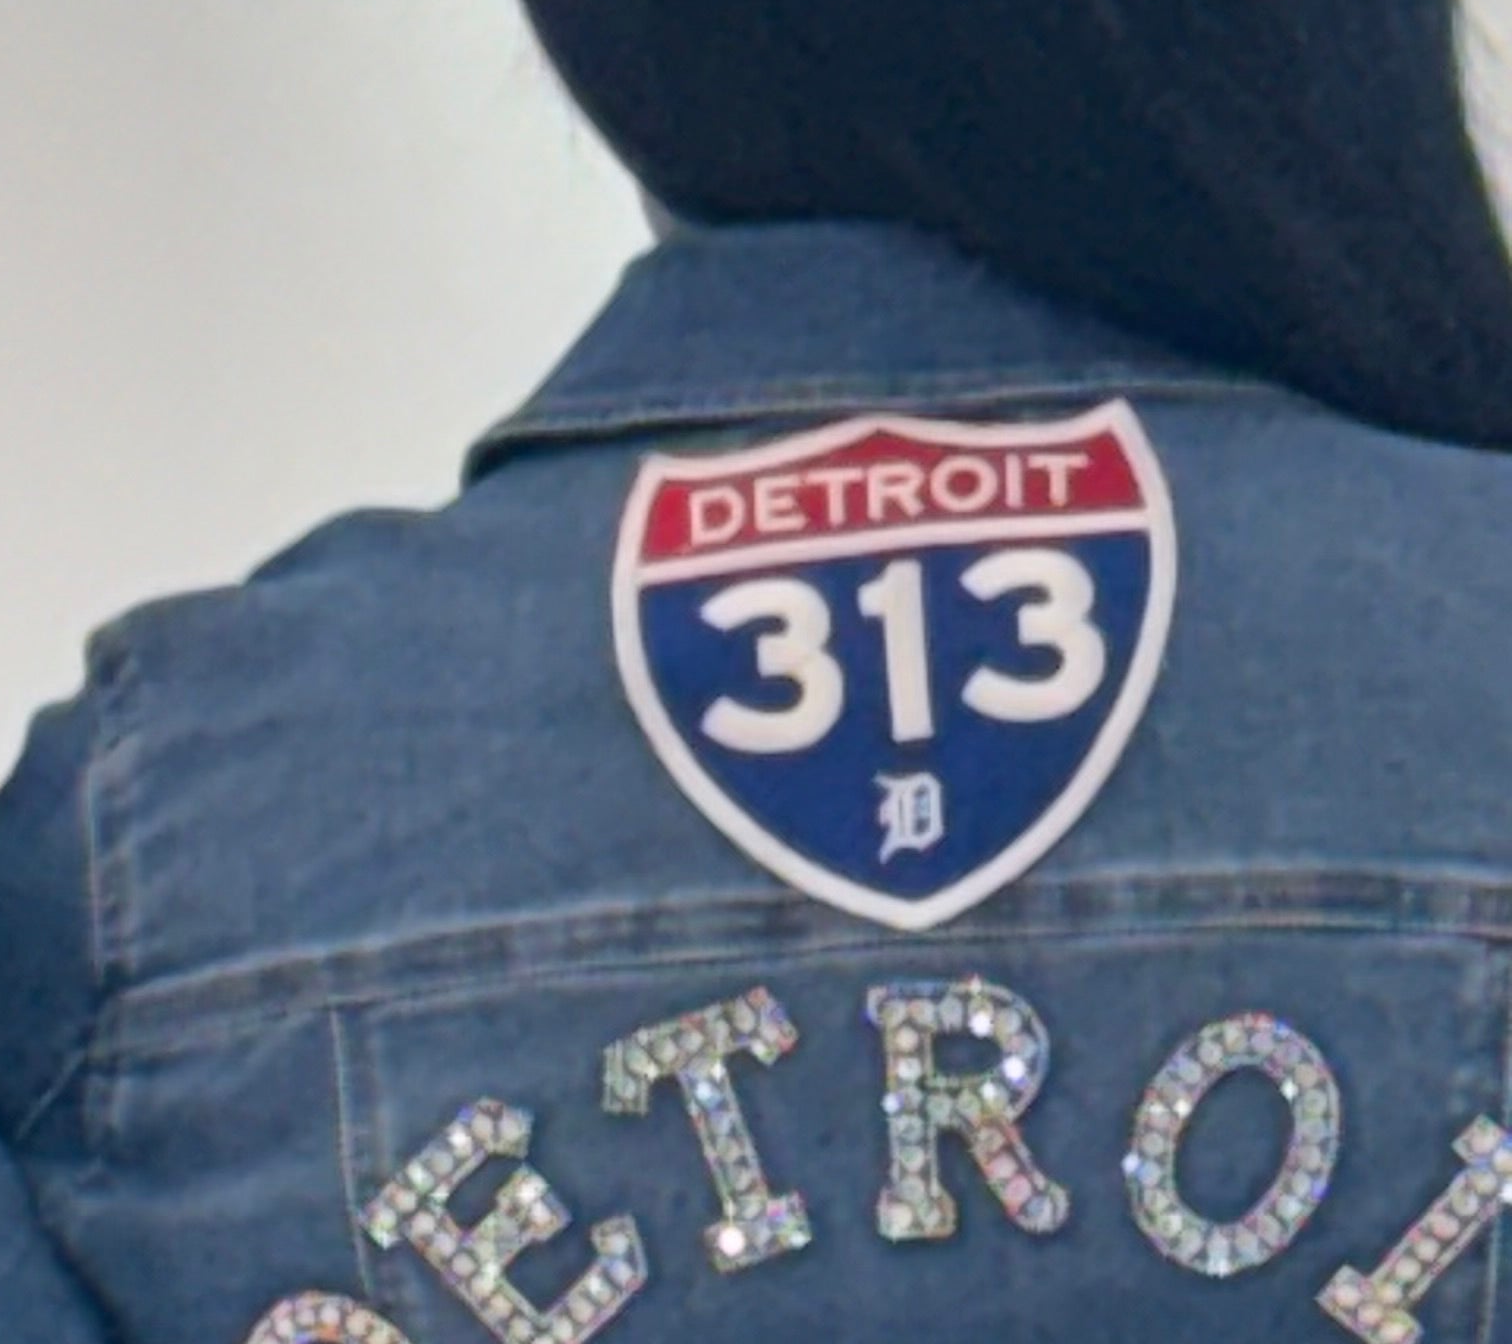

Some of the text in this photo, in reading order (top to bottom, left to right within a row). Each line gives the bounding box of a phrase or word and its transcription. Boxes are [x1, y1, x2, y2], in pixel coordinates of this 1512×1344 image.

[687, 453, 1090, 547] DETROIT
[699, 547, 1106, 755] 313
[873, 770, 945, 865] D
